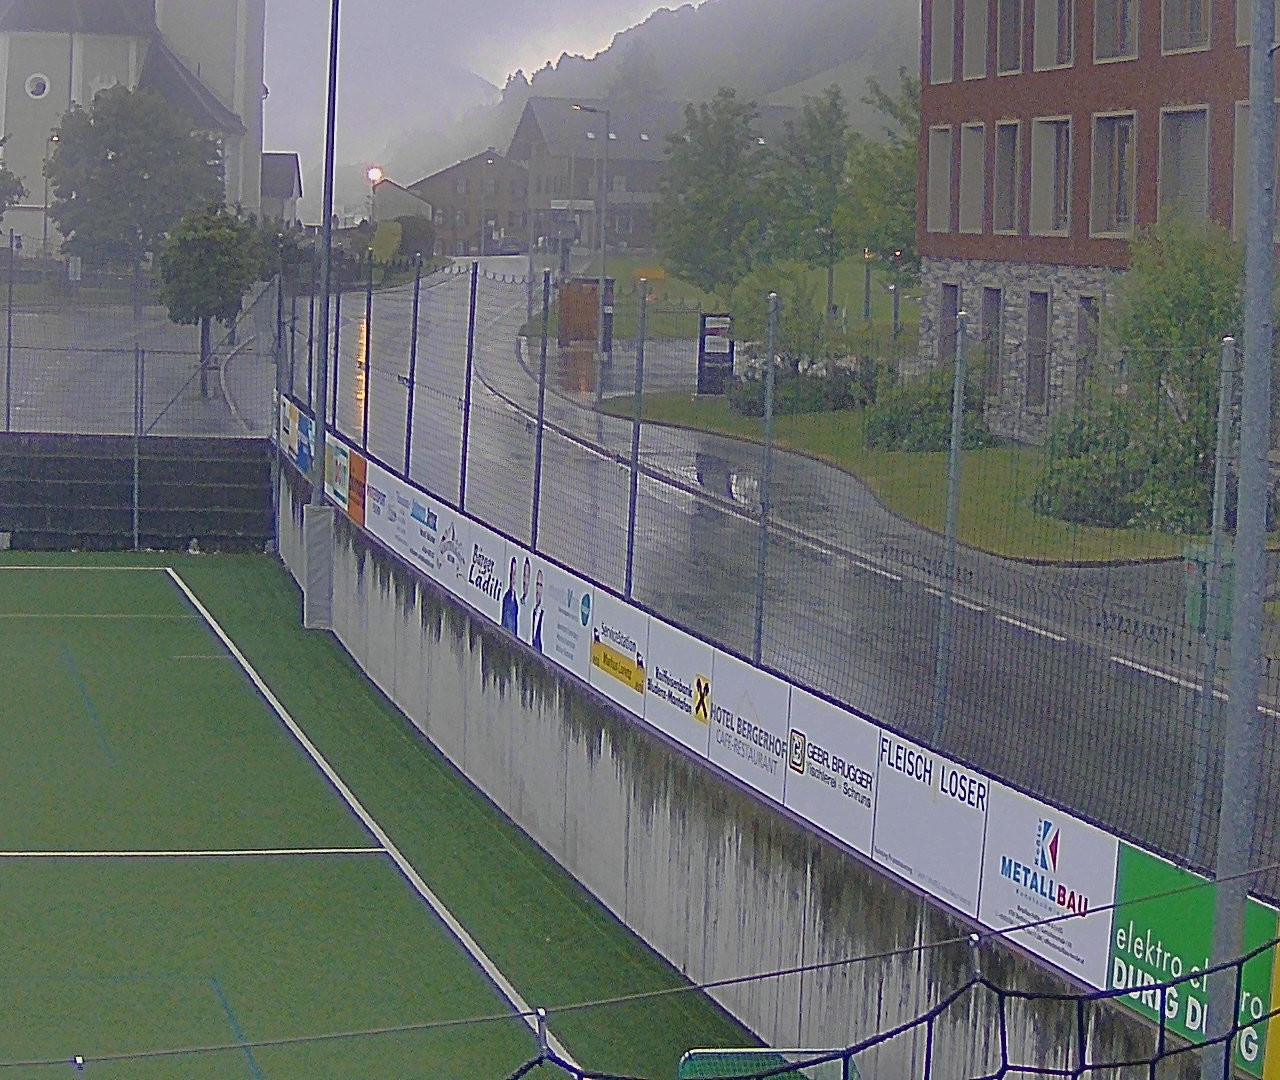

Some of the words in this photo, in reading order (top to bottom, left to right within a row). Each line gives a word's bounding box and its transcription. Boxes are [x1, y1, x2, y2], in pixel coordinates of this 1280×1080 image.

[711, 702, 735, 732] HOTEL
[736, 717, 788, 760] BERGERHOF
[807, 742, 830, 769] GEBR.
[879, 737, 933, 786] FLEISCH
[940, 765, 987, 812] LOSER
[1000, 855, 1089, 918] METALLBAU
[1116, 920, 1183, 979] elektro
